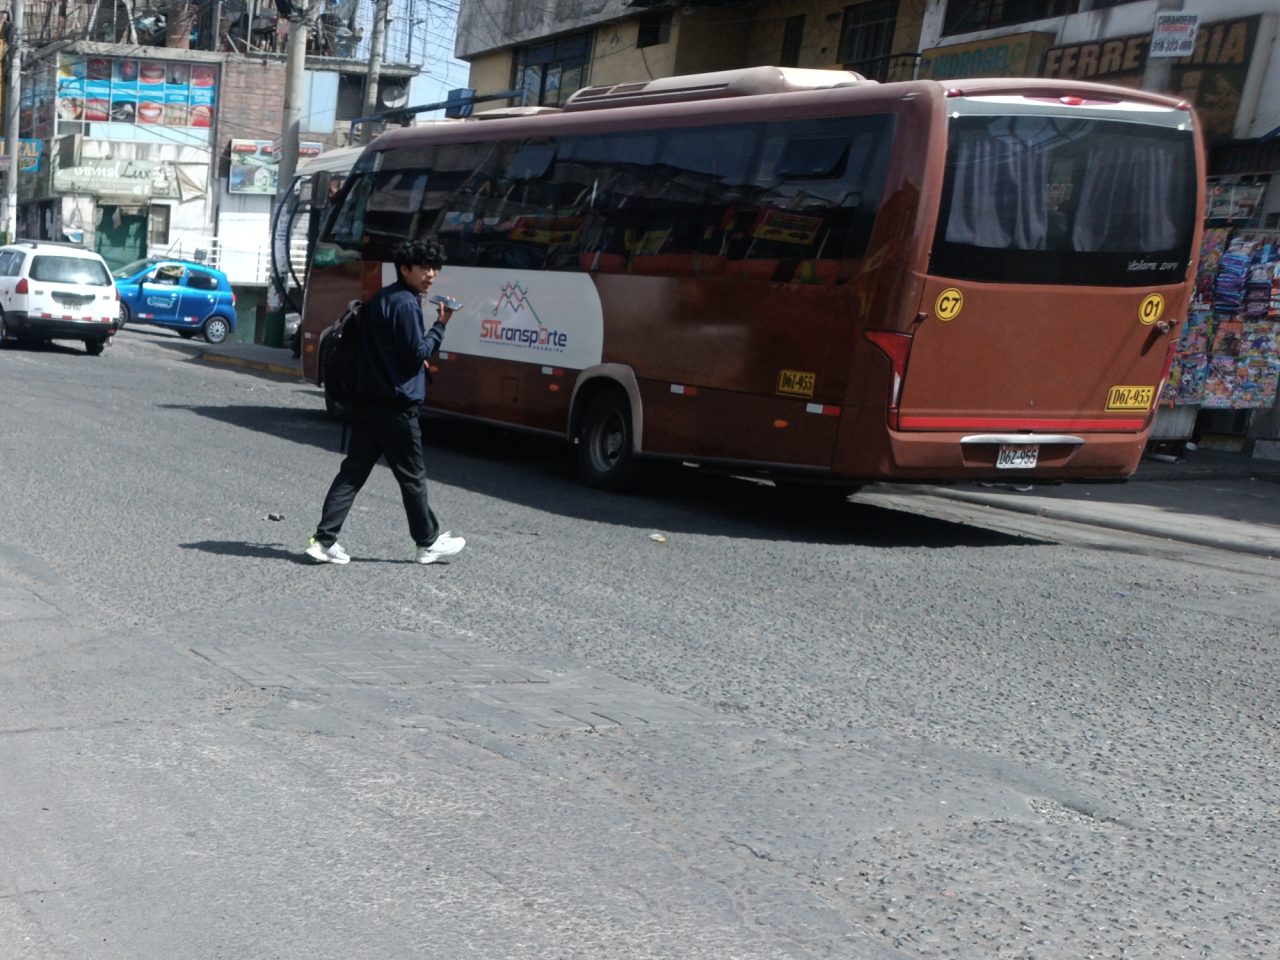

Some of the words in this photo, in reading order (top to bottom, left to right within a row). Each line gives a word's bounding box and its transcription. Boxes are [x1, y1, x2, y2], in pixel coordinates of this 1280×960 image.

[1042, 22, 1248, 79] FERRERIA
[939, 296, 960, 313] C7
[1144, 300, 1161, 317] 01
[781, 372, 813, 391] D6Z-955
[1111, 388, 1152, 405] D6Z-955
[999, 450, 1037, 465] D6Z-955
